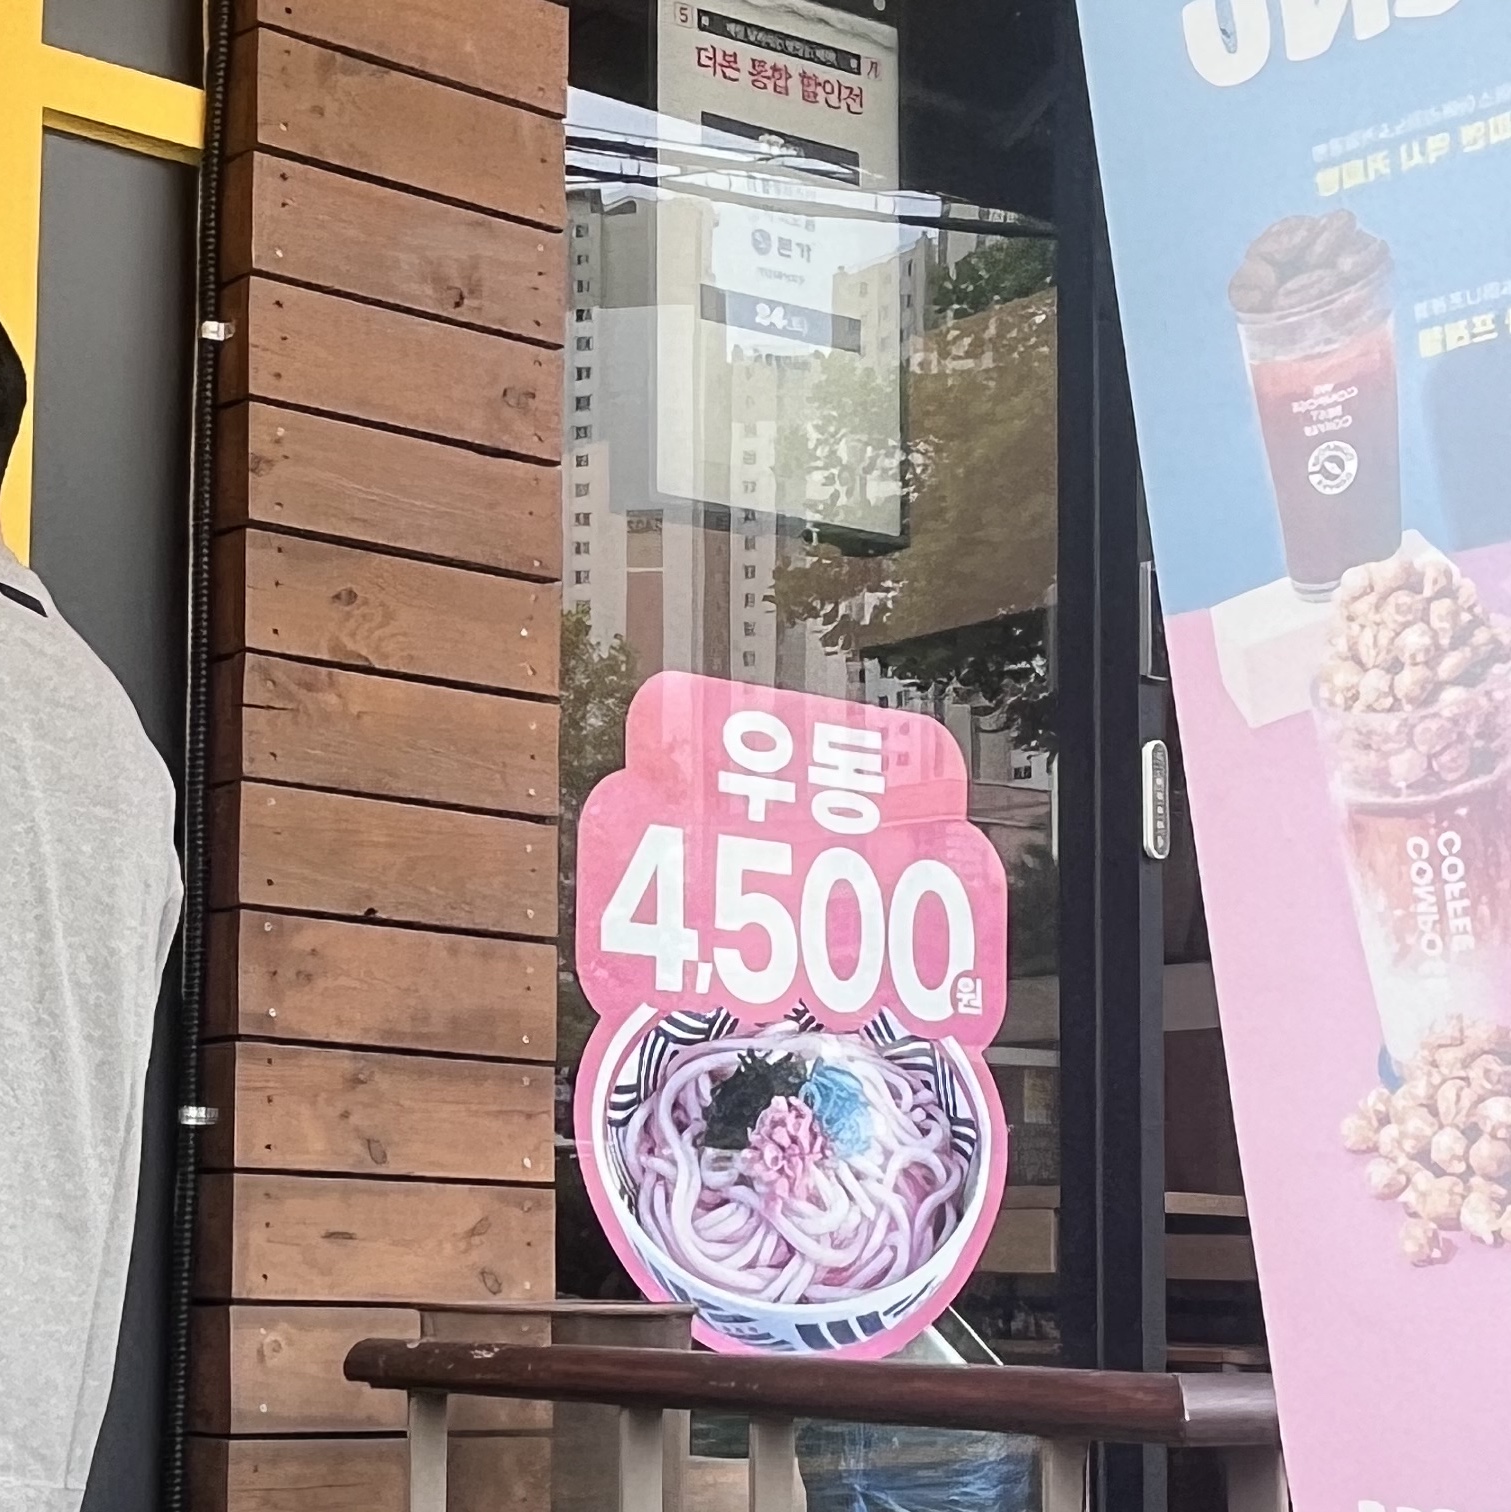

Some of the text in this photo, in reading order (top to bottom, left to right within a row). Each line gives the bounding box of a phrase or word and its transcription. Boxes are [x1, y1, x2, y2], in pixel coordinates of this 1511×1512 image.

[695, 45, 740, 82] 더본
[799, 69, 865, 115] 할인전
[717, 710, 886, 836] 우동
